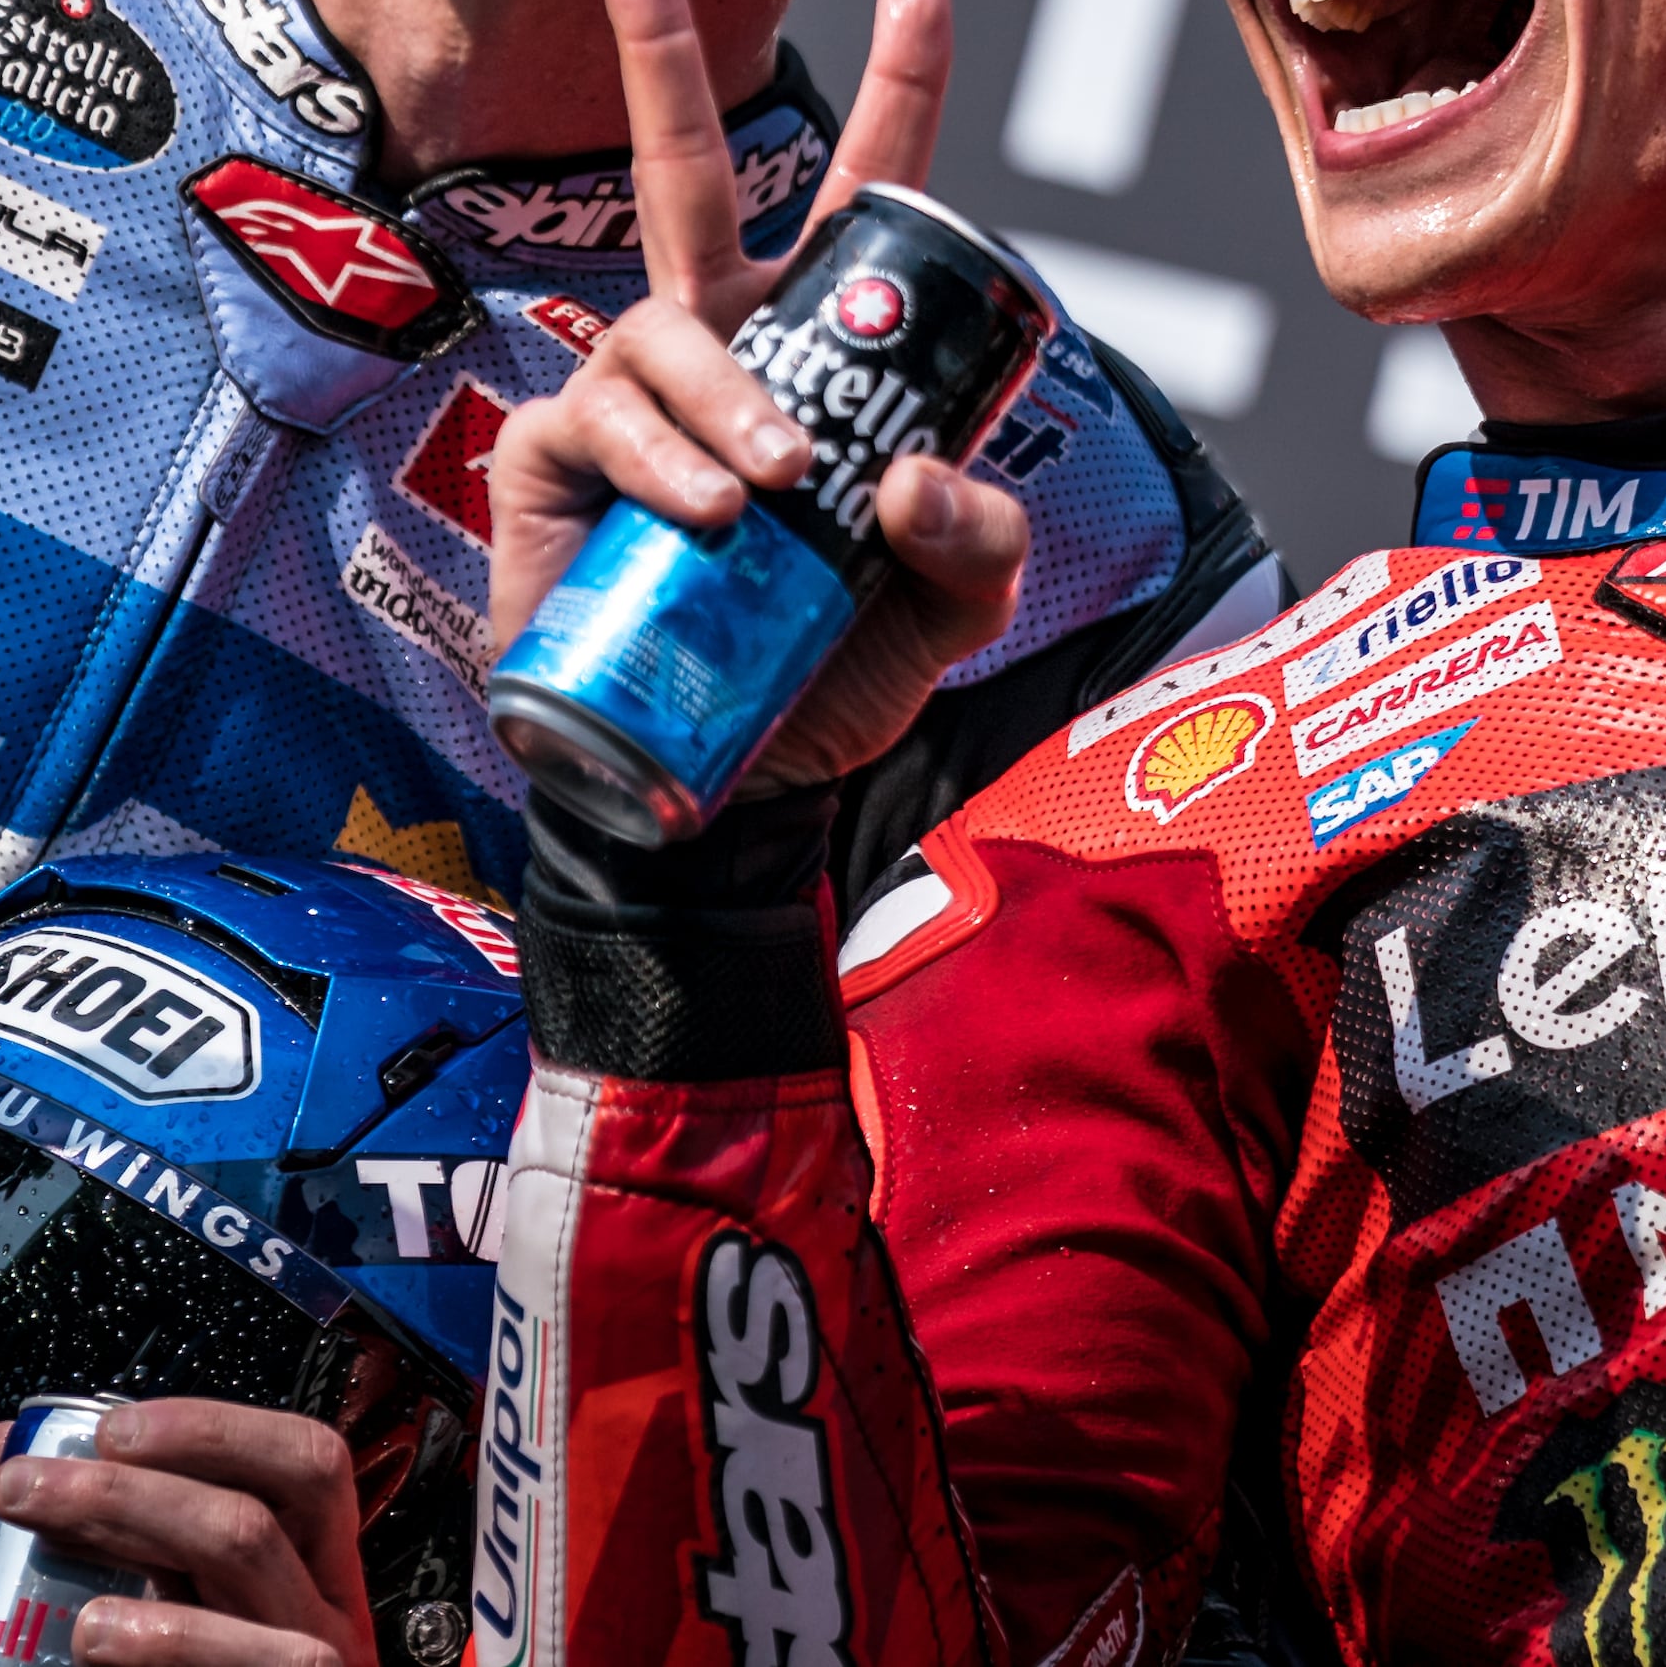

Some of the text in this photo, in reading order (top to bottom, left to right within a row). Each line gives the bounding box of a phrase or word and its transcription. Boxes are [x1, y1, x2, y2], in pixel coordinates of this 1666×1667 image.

[1515, 478, 1640, 542] TIM
[1356, 558, 1523, 659] riello
[1304, 621, 1552, 752] CARRERA
[1310, 743, 1437, 837] SAP
[62, 1115, 297, 1282] WINGS
[474, 1280, 542, 1640] Unipol
